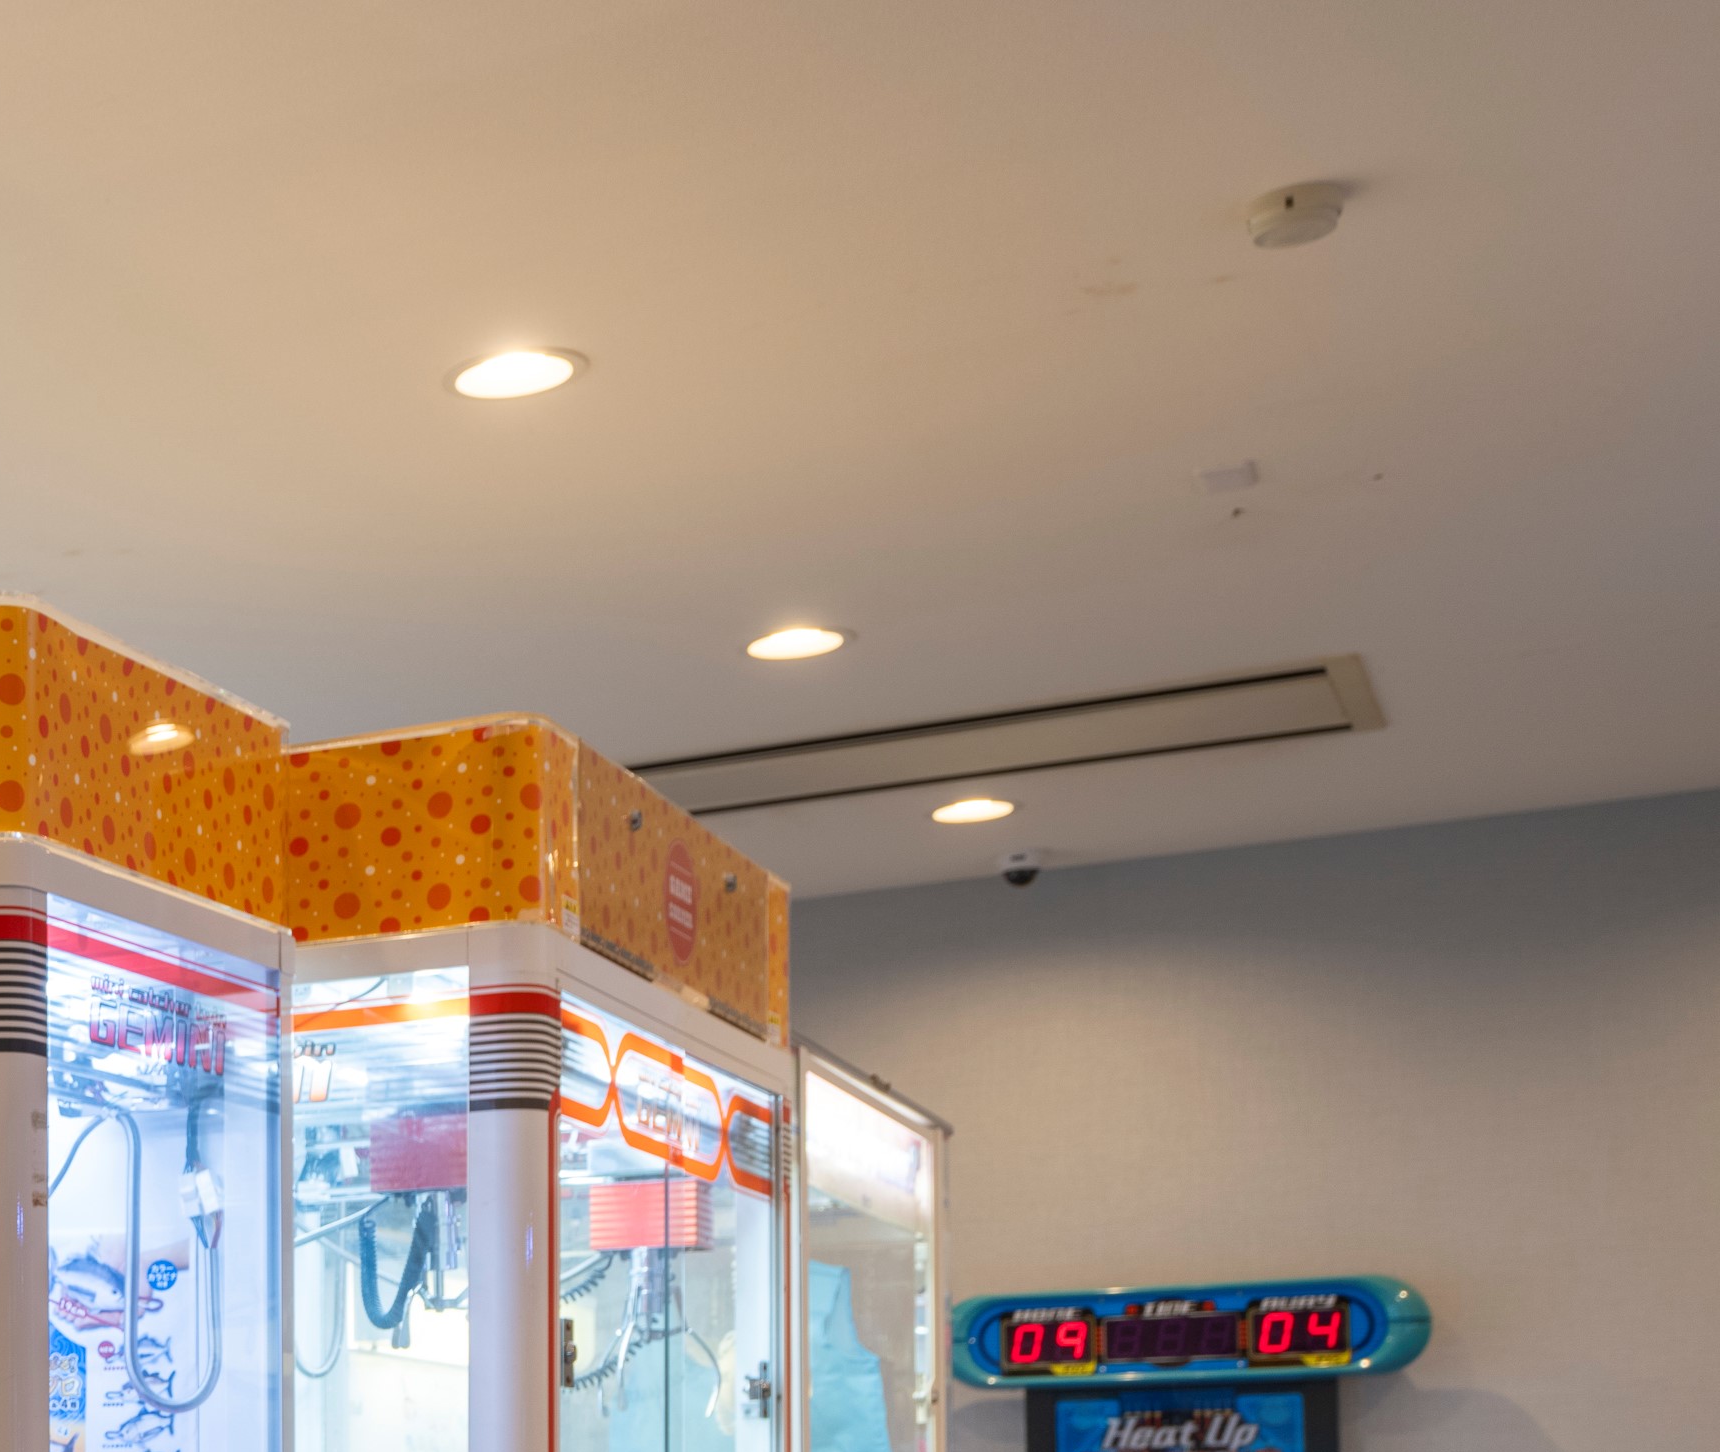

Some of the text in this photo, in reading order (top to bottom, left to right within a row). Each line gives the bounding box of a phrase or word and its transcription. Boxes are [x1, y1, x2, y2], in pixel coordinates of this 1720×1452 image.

[89, 1000, 226, 1076] GEMINI
[1010, 1320, 1088, 1364] 09
[1258, 1311, 1342, 1354] 04
[1101, 1411, 1259, 1452] Heat Up
